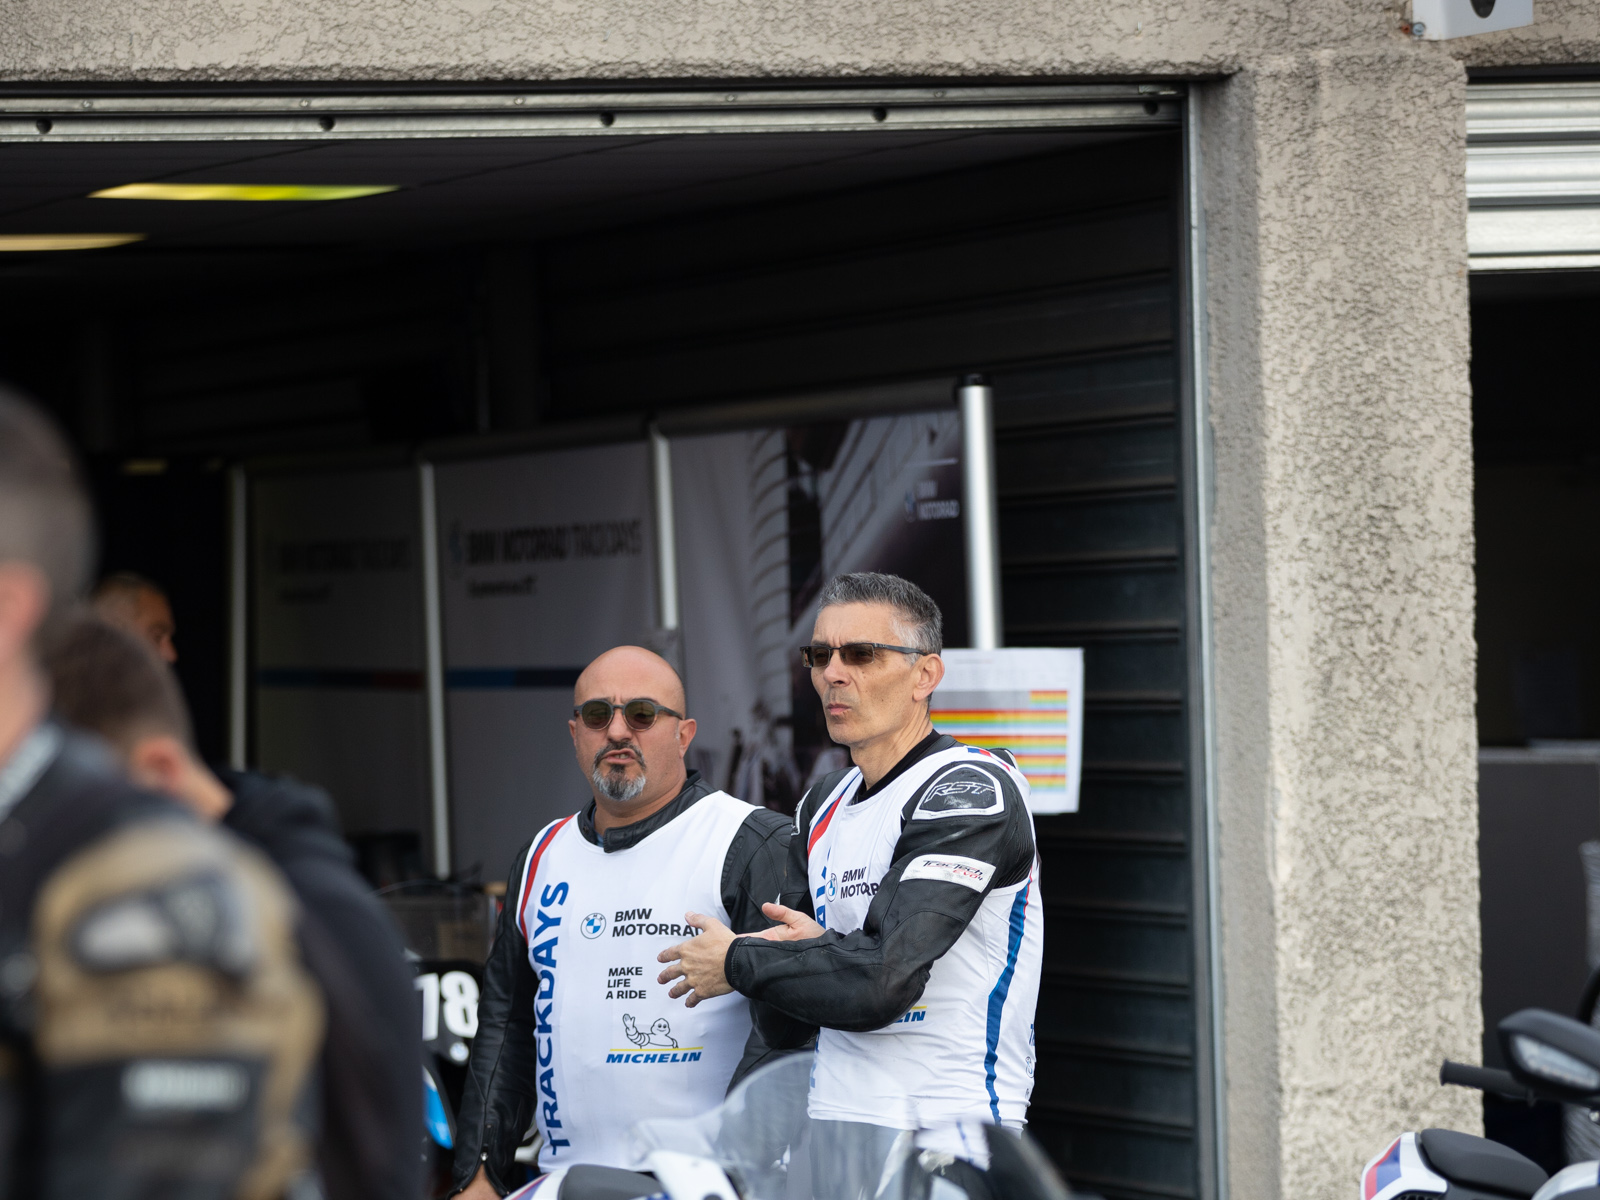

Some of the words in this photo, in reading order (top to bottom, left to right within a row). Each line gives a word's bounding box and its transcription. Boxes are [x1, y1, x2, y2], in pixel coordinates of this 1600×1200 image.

[924, 781, 996, 804] RST
[841, 866, 867, 883] BMW
[614, 908, 653, 923] BMW
[608, 966, 643, 977] MAKE
[607, 978, 631, 988] LIFE
[605, 990, 614, 1000] A
[616, 989, 647, 999] RIDE
[413, 970, 480, 1041] 18
[533, 881, 571, 1156] TRACKDAYS
[605, 1051, 702, 1064] MICHELIN
